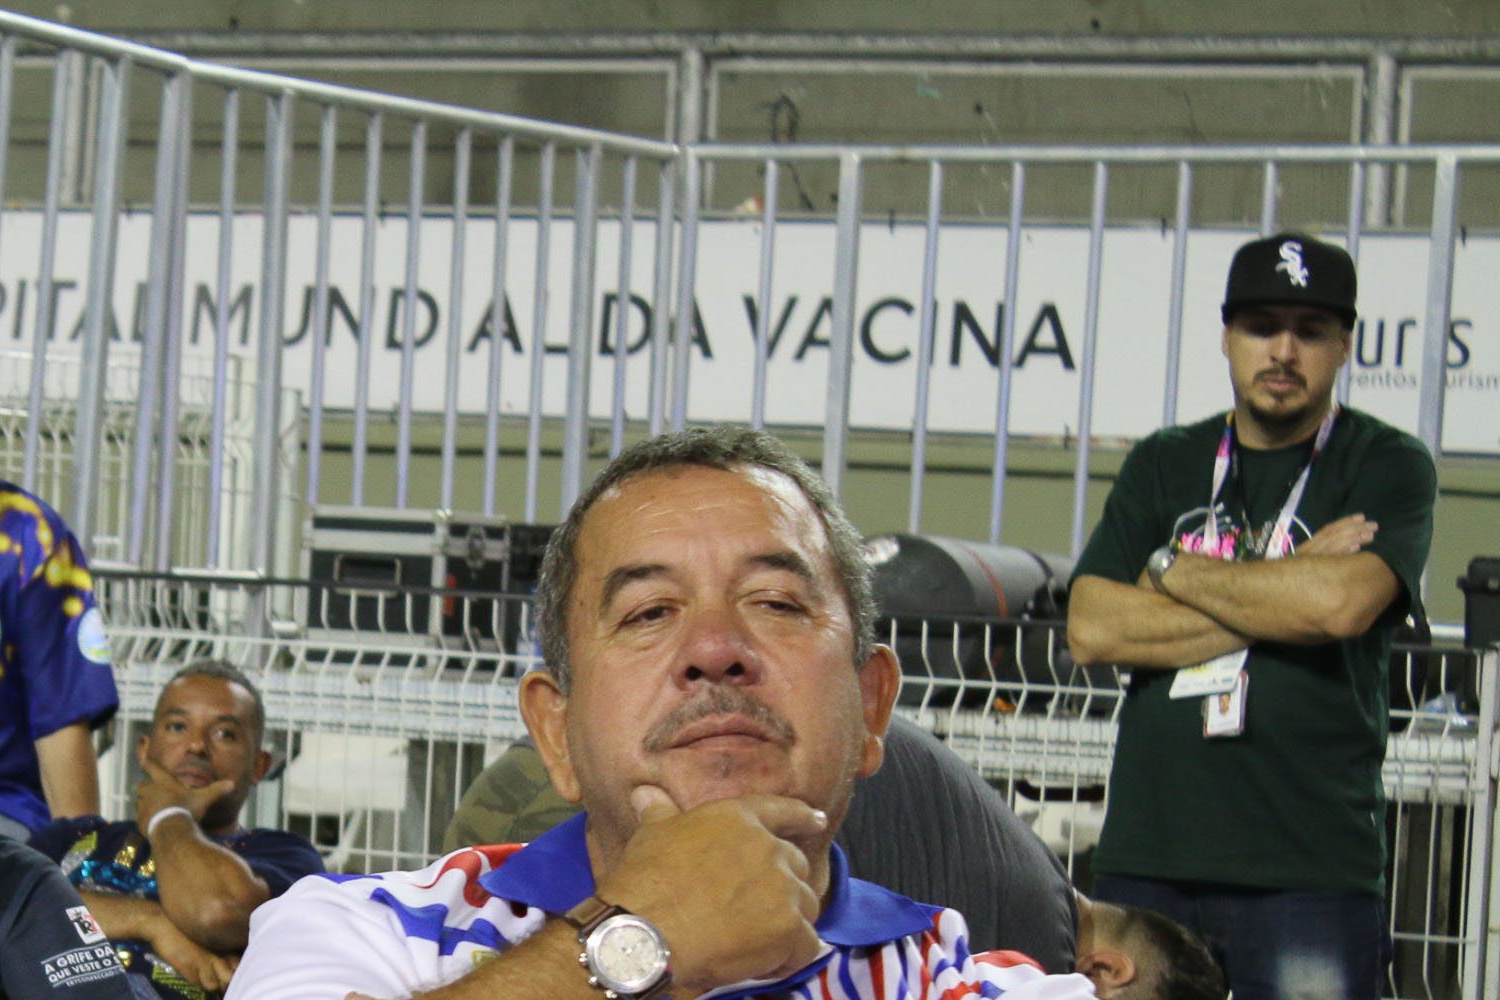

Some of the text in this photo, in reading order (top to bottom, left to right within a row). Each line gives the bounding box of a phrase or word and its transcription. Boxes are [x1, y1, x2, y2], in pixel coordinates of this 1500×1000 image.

[741, 293, 1076, 370] VACINA
[44, 945, 115, 975] A GRIFE DA
[48, 967, 72, 983] QUE
[71, 961, 102, 974] VESTE
[102, 958, 112, 966] O
